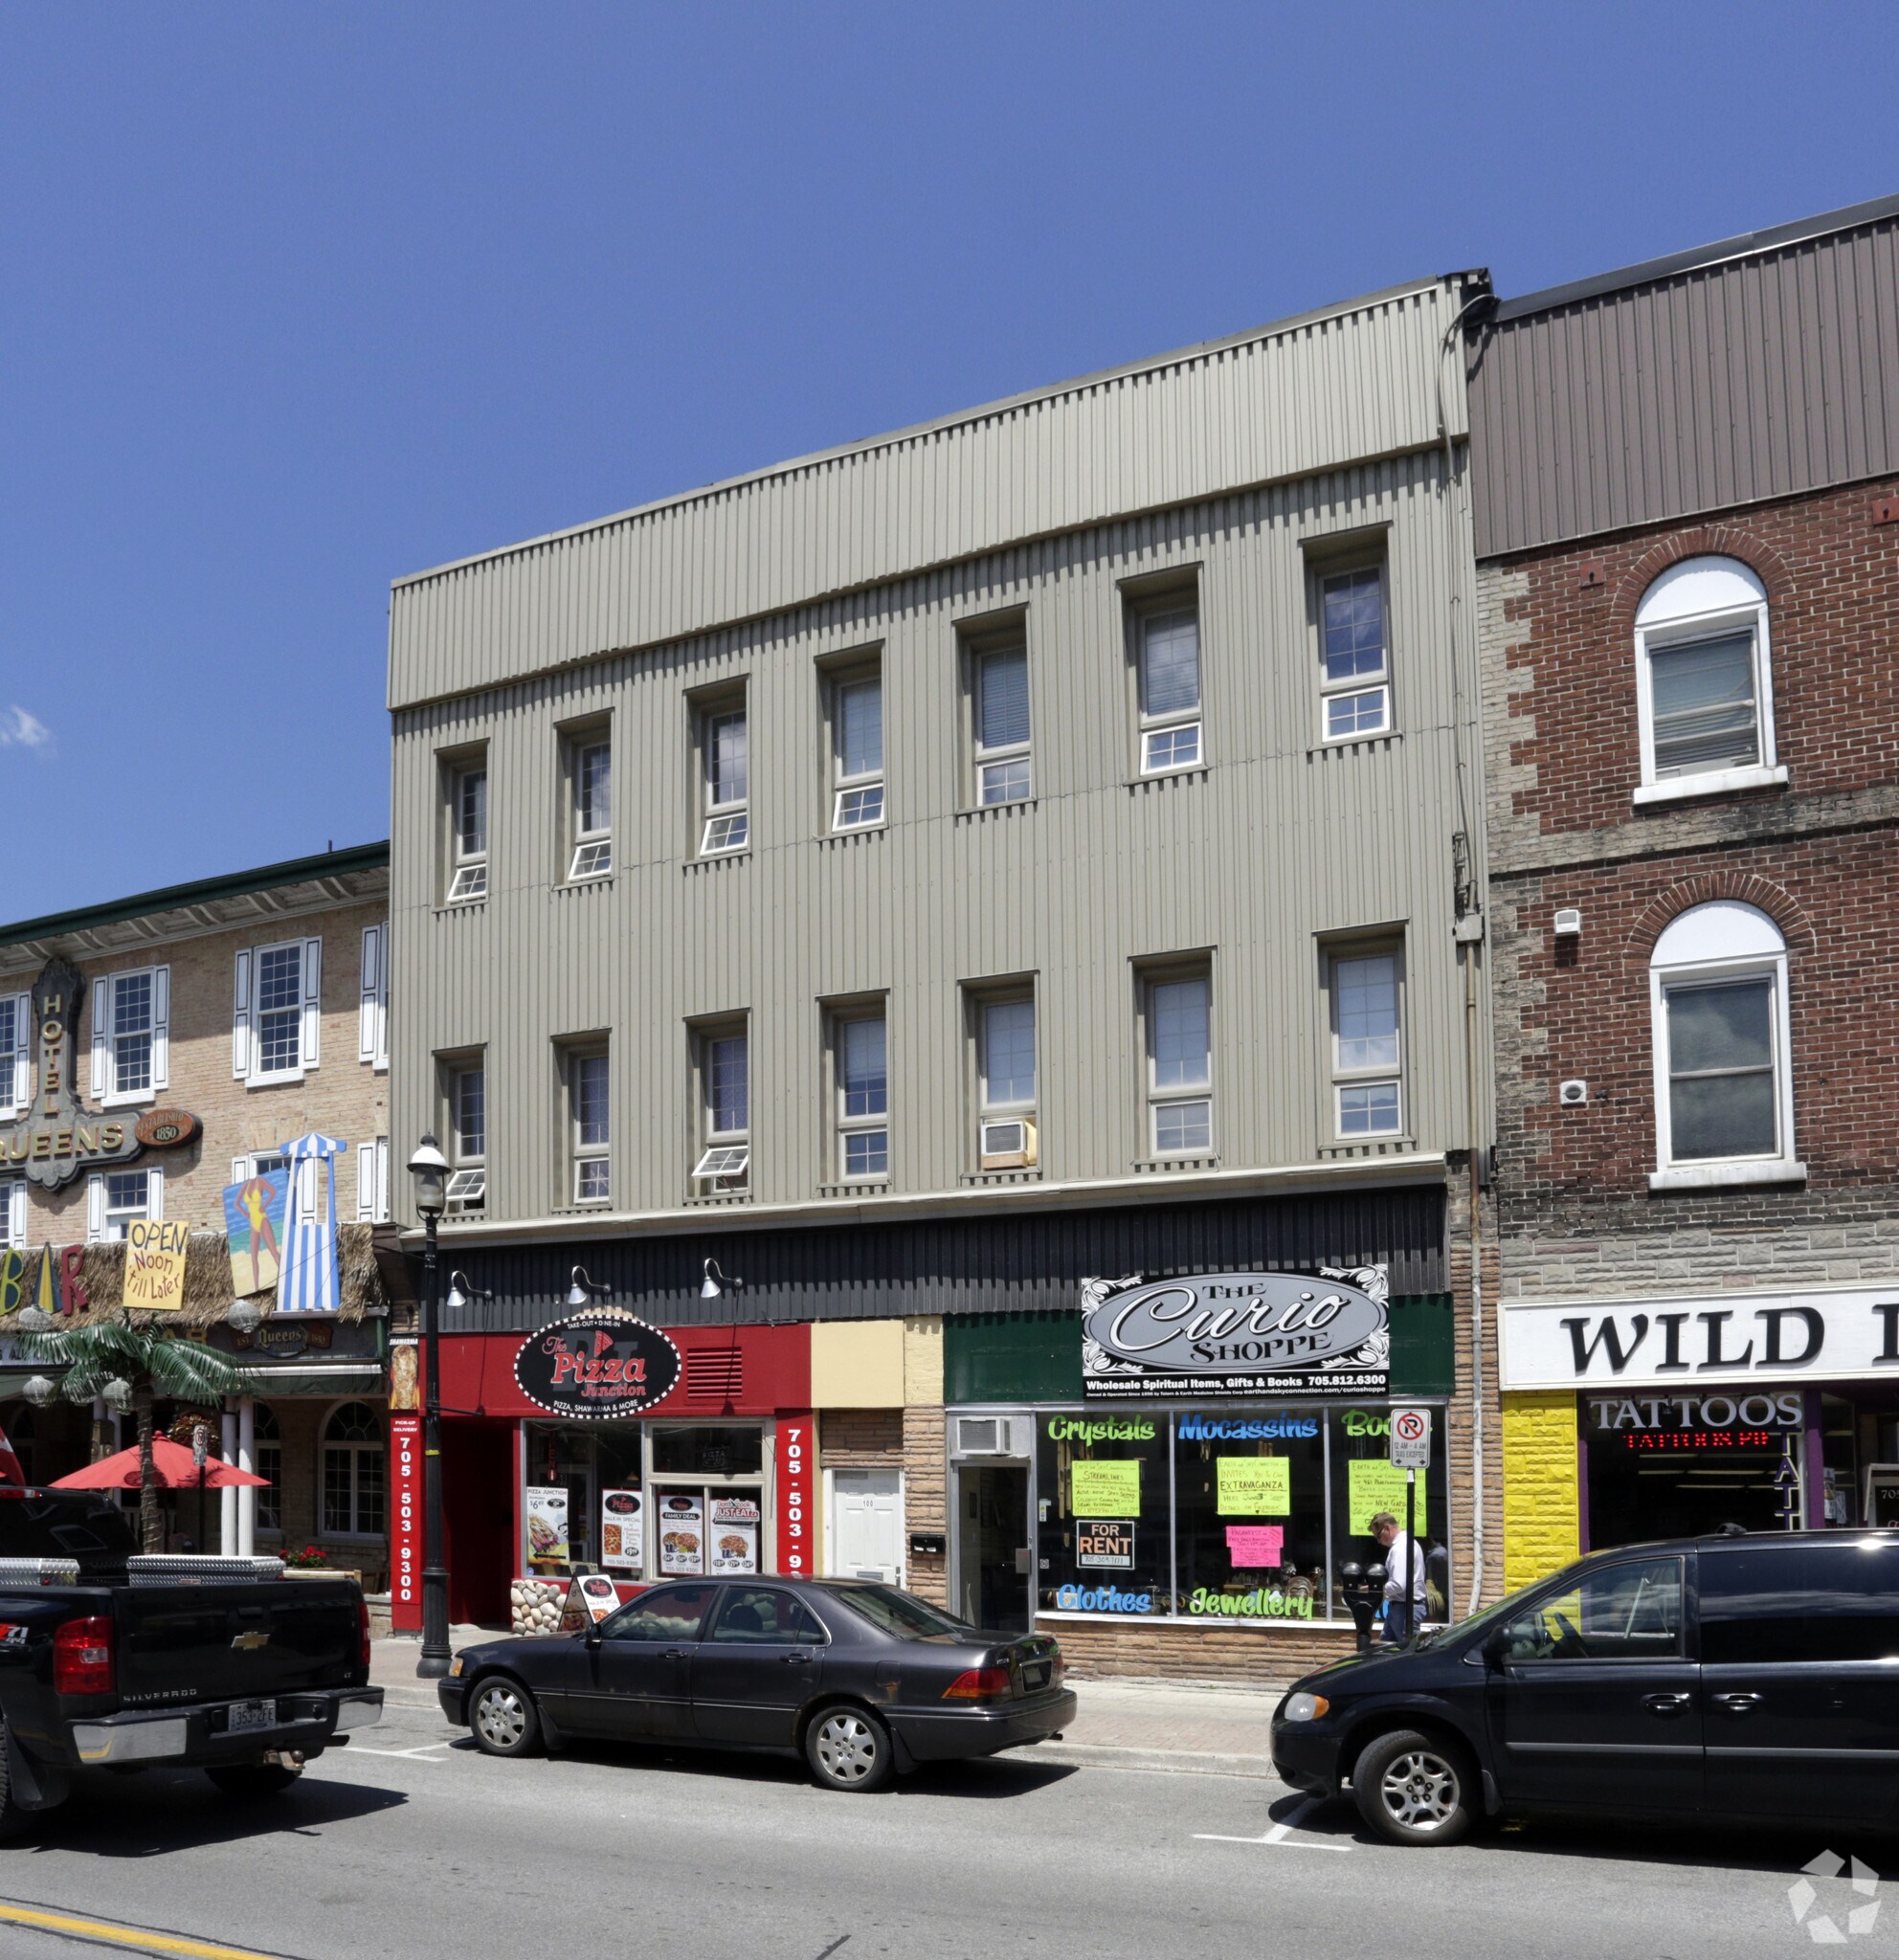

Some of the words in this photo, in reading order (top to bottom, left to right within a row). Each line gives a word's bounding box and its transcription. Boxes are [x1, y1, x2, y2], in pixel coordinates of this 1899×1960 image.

[41, 993, 63, 1114] HOTEL
[156, 1125, 176, 1141] 1850
[132, 1222, 188, 1257] OPEN
[134, 1250, 173, 1276] Noon
[0, 1241, 89, 1317] BAR
[150, 1272, 181, 1301] Later
[1202, 1282, 1267, 1300] THE
[568, 1321, 593, 1329] TAKE-OUT
[1109, 1286, 1352, 1352] Curio
[259, 1327, 302, 1348] Queens
[542, 1336, 567, 1355] The
[1190, 1331, 1334, 1364] SHOPPE
[1560, 1306, 1825, 1376] WILD
[550, 1350, 647, 1384] Pizza
[581, 1383, 646, 1397] Junction
[1086, 1380, 1141, 1390] Wholesale
[1143, 1379, 1189, 1391] Spiritual
[1190, 1379, 1224, 1389] Items,
[1226, 1377, 1253, 1388] Gifts
[1256, 1377, 1264, 1387] &
[1267, 1377, 1303, 1387] Books
[1307, 1375, 1386, 1386] 705.812.6300
[1243, 1387, 1386, 1395] earthandskyconnection.com/curioshoppe
[553, 1400, 573, 1412] PIZZA,
[619, 1399, 638, 1411] MORE
[1590, 1393, 1802, 1429] TATTOOS
[1048, 1414, 1155, 1447] Crystals
[1178, 1412, 1318, 1439] Mocassins
[1219, 1481, 1284, 1491] EXTRAVAGANZA
[400, 1437, 411, 1601] 705-503-9300
[1091, 1524, 1119, 1536] FOR
[1080, 1536, 1132, 1554] RENT
[1058, 1584, 1151, 1613] Clothes
[1189, 1588, 1313, 1620] Jewellery
[123, 1688, 197, 1702] SILVERADO
